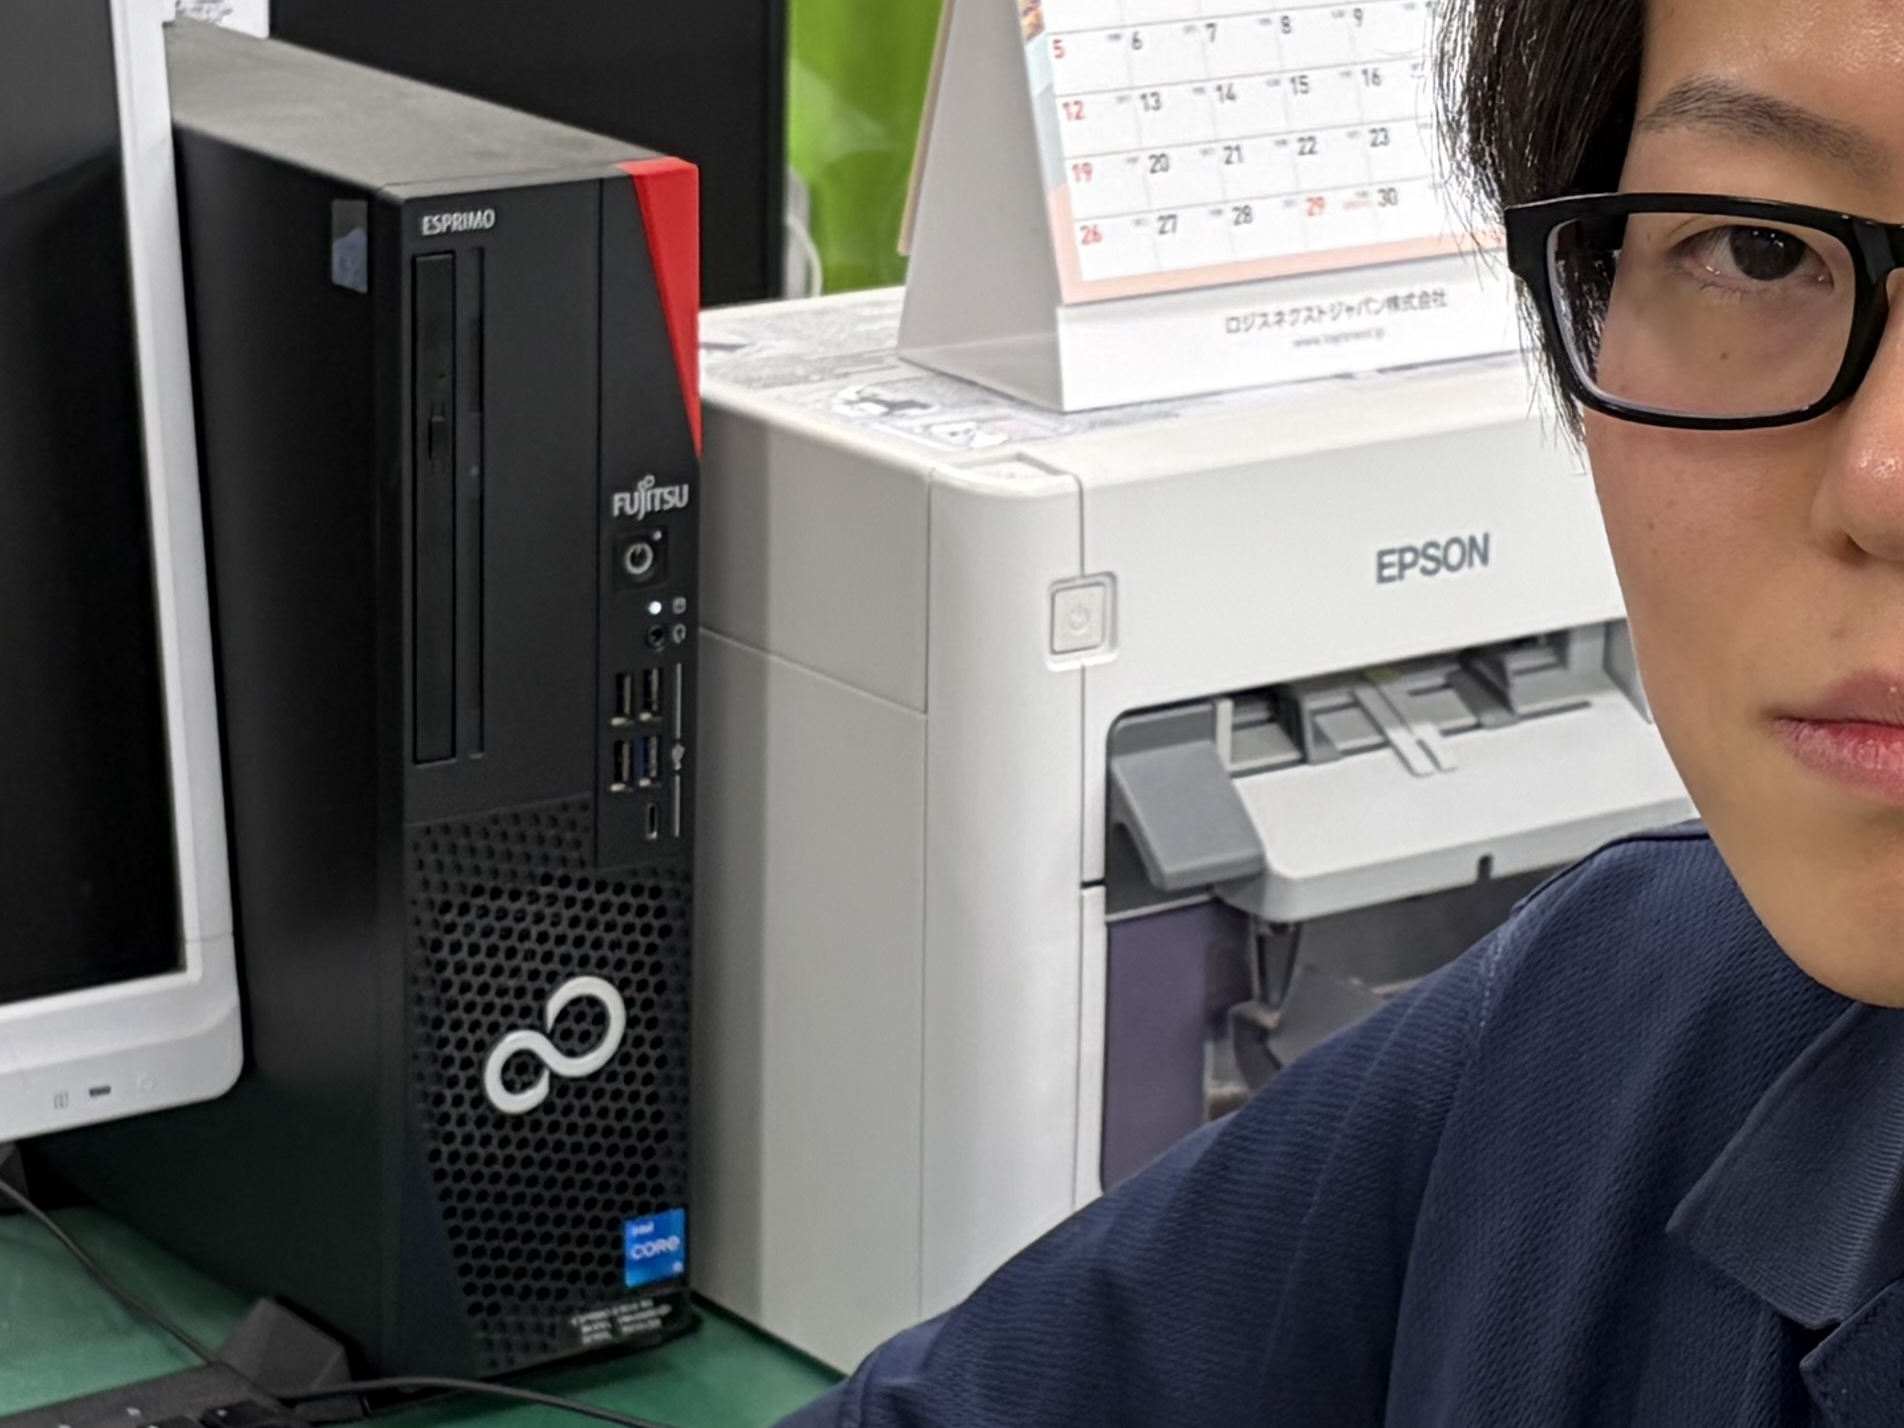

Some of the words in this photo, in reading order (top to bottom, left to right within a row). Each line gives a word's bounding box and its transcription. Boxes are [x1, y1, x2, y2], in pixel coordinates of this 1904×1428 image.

[1052, 39, 1065, 58] 5
[1130, 31, 1143, 50] 6
[1205, 23, 1218, 43] 7
[1280, 15, 1292, 34] 8
[1353, 8, 1365, 27] 9
[1062, 100, 1086, 121] 12
[1140, 92, 1162, 111] 13
[1216, 83, 1237, 103] 14
[1290, 75, 1311, 95] 15
[1361, 68, 1383, 87] 16
[1071, 162, 1094, 182] 19
[1148, 153, 1171, 173] 20
[1222, 145, 1244, 165] 21
[1297, 136, 1319, 156] 22
[1369, 128, 1390, 147] 23
[421, 209, 496, 236] ESPRIMO
[1079, 224, 1102, 245] 26
[1157, 214, 1179, 235] 27
[1231, 205, 1254, 226] 28
[1306, 196, 1326, 216] 29
[1377, 188, 1399, 207] 30
[1225, 288, 1448, 335] ロジスネクストジャパン株式会社
[612, 475, 690, 521] FUJITSU
[1376, 531, 1490, 584] EPSON
